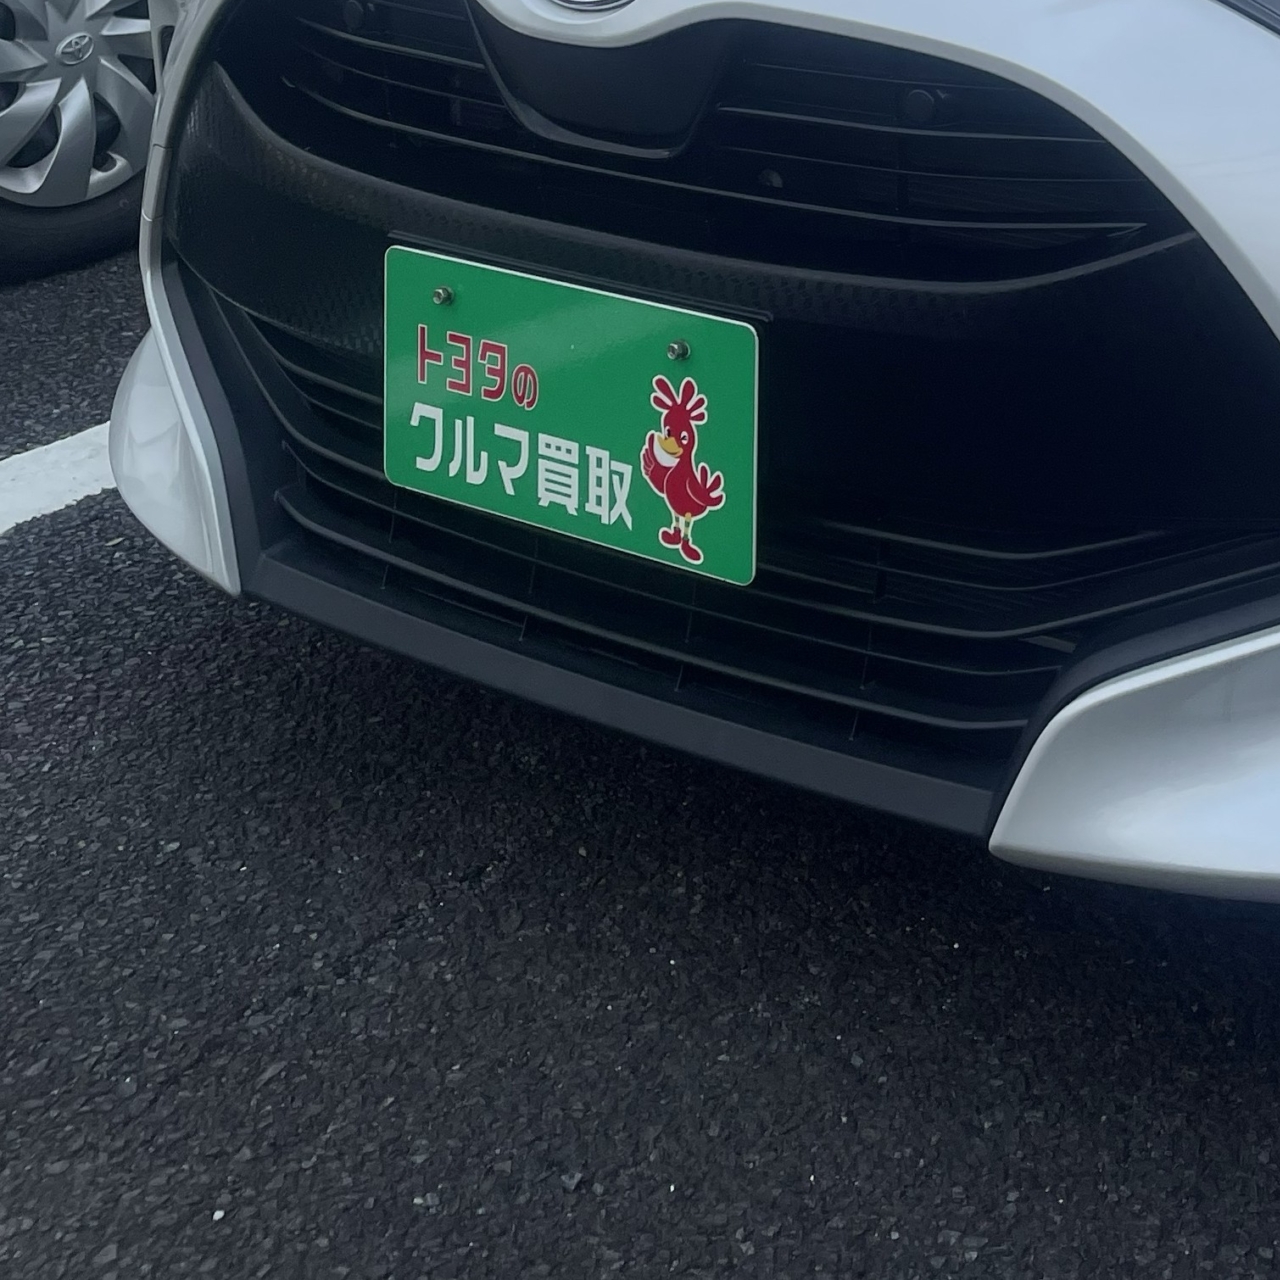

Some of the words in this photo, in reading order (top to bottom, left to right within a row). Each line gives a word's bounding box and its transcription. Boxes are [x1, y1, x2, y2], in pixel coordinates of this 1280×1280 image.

[418, 324, 539, 410] トヨタの
[410, 402, 632, 530] クルマ買取
